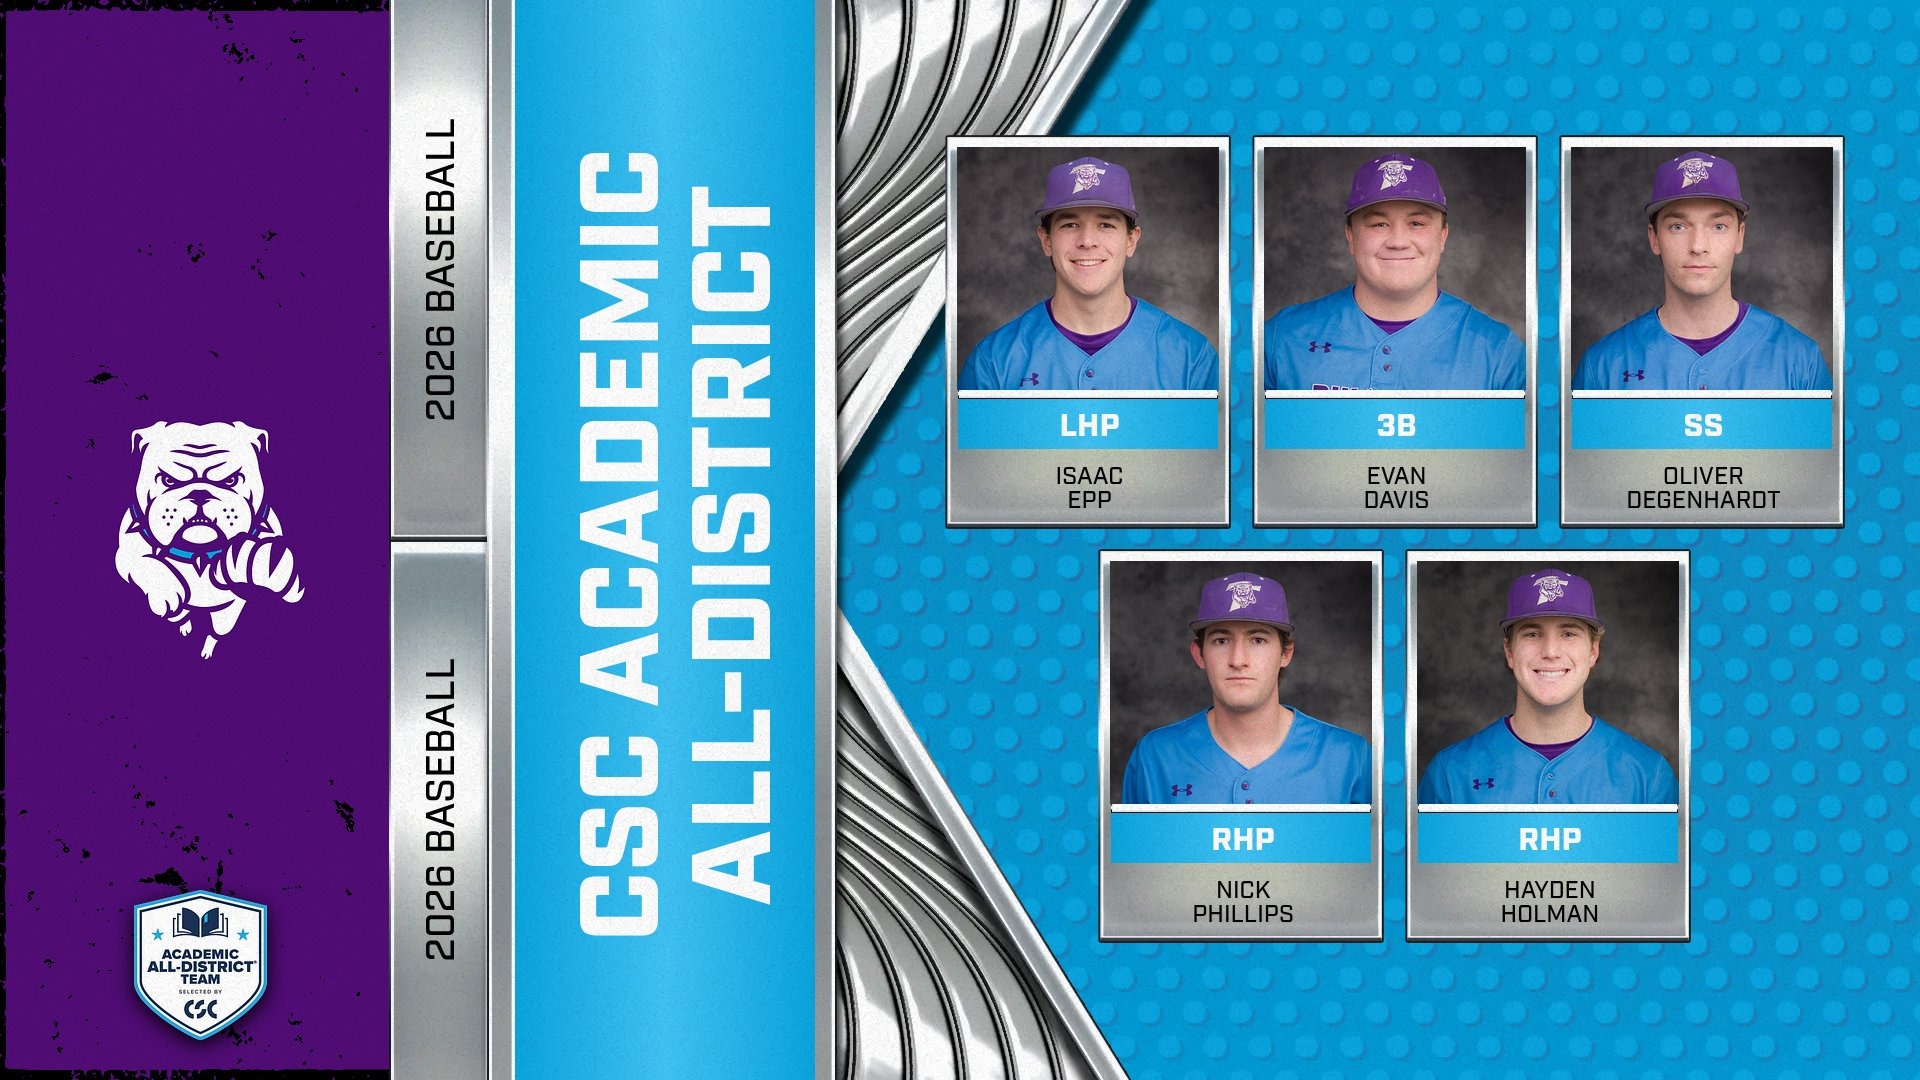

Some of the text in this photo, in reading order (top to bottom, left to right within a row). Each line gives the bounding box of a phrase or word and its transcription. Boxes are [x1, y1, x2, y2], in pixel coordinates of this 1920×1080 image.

[425, 118, 455, 420] 2026 BASEBALL
[1061, 413, 1120, 437] LHP
[1377, 413, 1416, 437] 3B
[1684, 413, 1723, 437] SS
[1056, 466, 1123, 485] ISAAC
[1367, 466, 1425, 485] EVAN
[1663, 466, 1743, 485] OLIVER
[1068, 490, 1112, 509] EPP
[1364, 490, 1429, 509] DAVIS
[1627, 490, 1781, 509] DEGENHARDT
[579, 152, 659, 936] CSC ACADEMIC
[691, 186, 771, 905] ALL-DISTRICT
[425, 658, 455, 960] 2026 BASEBALL
[1212, 827, 1275, 851] RHP
[1519, 827, 1582, 851] RHP
[1216, 880, 1271, 899] NICK
[1505, 880, 1595, 899] HAYDEN
[1193, 904, 1293, 923] PHILLIPS
[1502, 904, 1598, 923] HOLMAN
[161, 949, 239, 960] ACADEMIC
[180, 974, 220, 985] TEAM
[184, 999, 218, 1019] CSC
